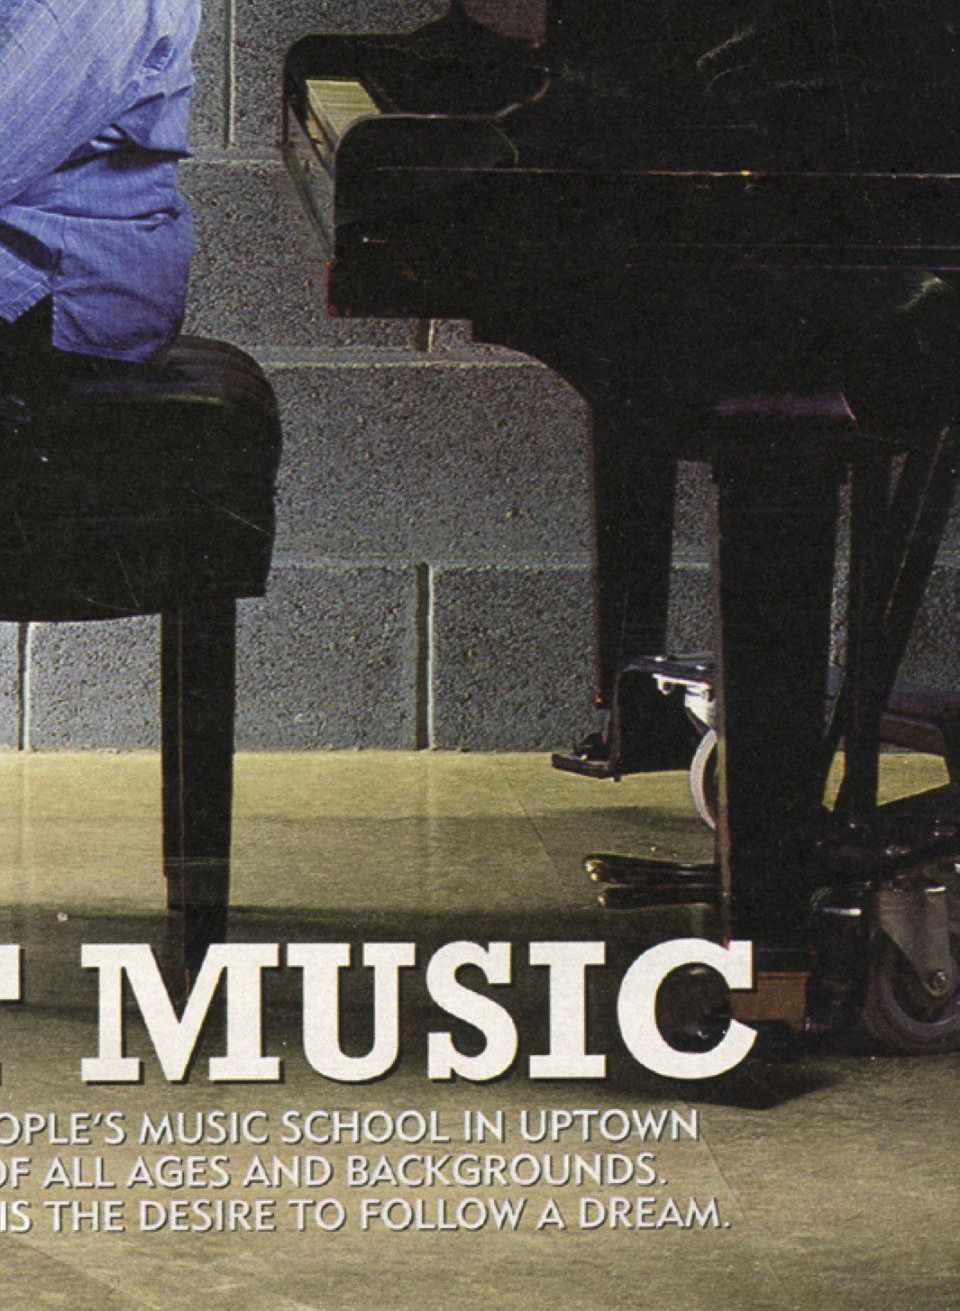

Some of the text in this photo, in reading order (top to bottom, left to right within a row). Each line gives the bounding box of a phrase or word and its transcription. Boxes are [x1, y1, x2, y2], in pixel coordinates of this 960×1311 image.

[80, 938, 757, 1082] MUSIC
[140, 1112, 268, 1144] MUSIC
[283, 1110, 450, 1143] SCHOOL
[464, 1110, 504, 1142] IN
[521, 1109, 699, 1140] UPTOWN
[43, 1156, 115, 1188] ALL
[127, 1155, 230, 1188] AGES
[242, 1155, 332, 1187] AND
[348, 1153, 667, 1187] BACKGROUNDS.
[43, 1200, 123, 1232] THE
[141, 1199, 276, 1231] DESIRE
[289, 1198, 347, 1230] TO
[360, 1198, 526, 1230] FOLLOW
[537, 1198, 565, 1229] A
[578, 1196, 731, 1230] DREAM.
